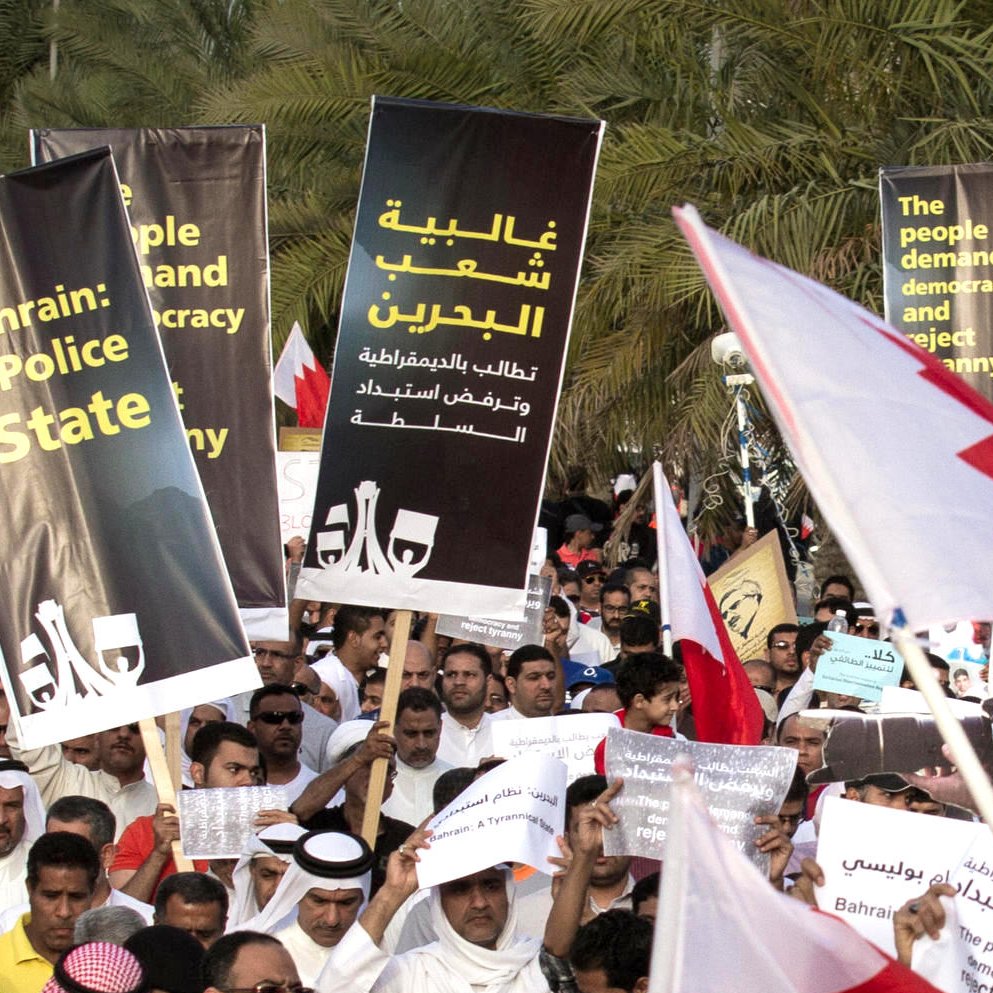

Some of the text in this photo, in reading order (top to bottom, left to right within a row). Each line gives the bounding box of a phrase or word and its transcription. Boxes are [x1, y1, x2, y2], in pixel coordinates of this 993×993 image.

[899, 196, 944, 216] The
[378, 199, 557, 251] غالبية
[900, 221, 988, 247] people
[375, 252, 551, 290] شعب
[368, 292, 545, 340] البحرين
[903, 301, 950, 322] and
[358, 348, 538, 381] تطالب بالديمقراطية
[356, 379, 530, 416] وترفض استبداد
[0, 391, 151, 463] State
[351, 410, 526, 443] السلطة
[461, 622, 523, 642] reject tyranny
[493, 787, 522, 804] نظام
[477, 820, 485, 829] A
[842, 859, 924, 884] بوليسي
[835, 897, 897, 920] Bahrai
[959, 925, 982, 946] The
